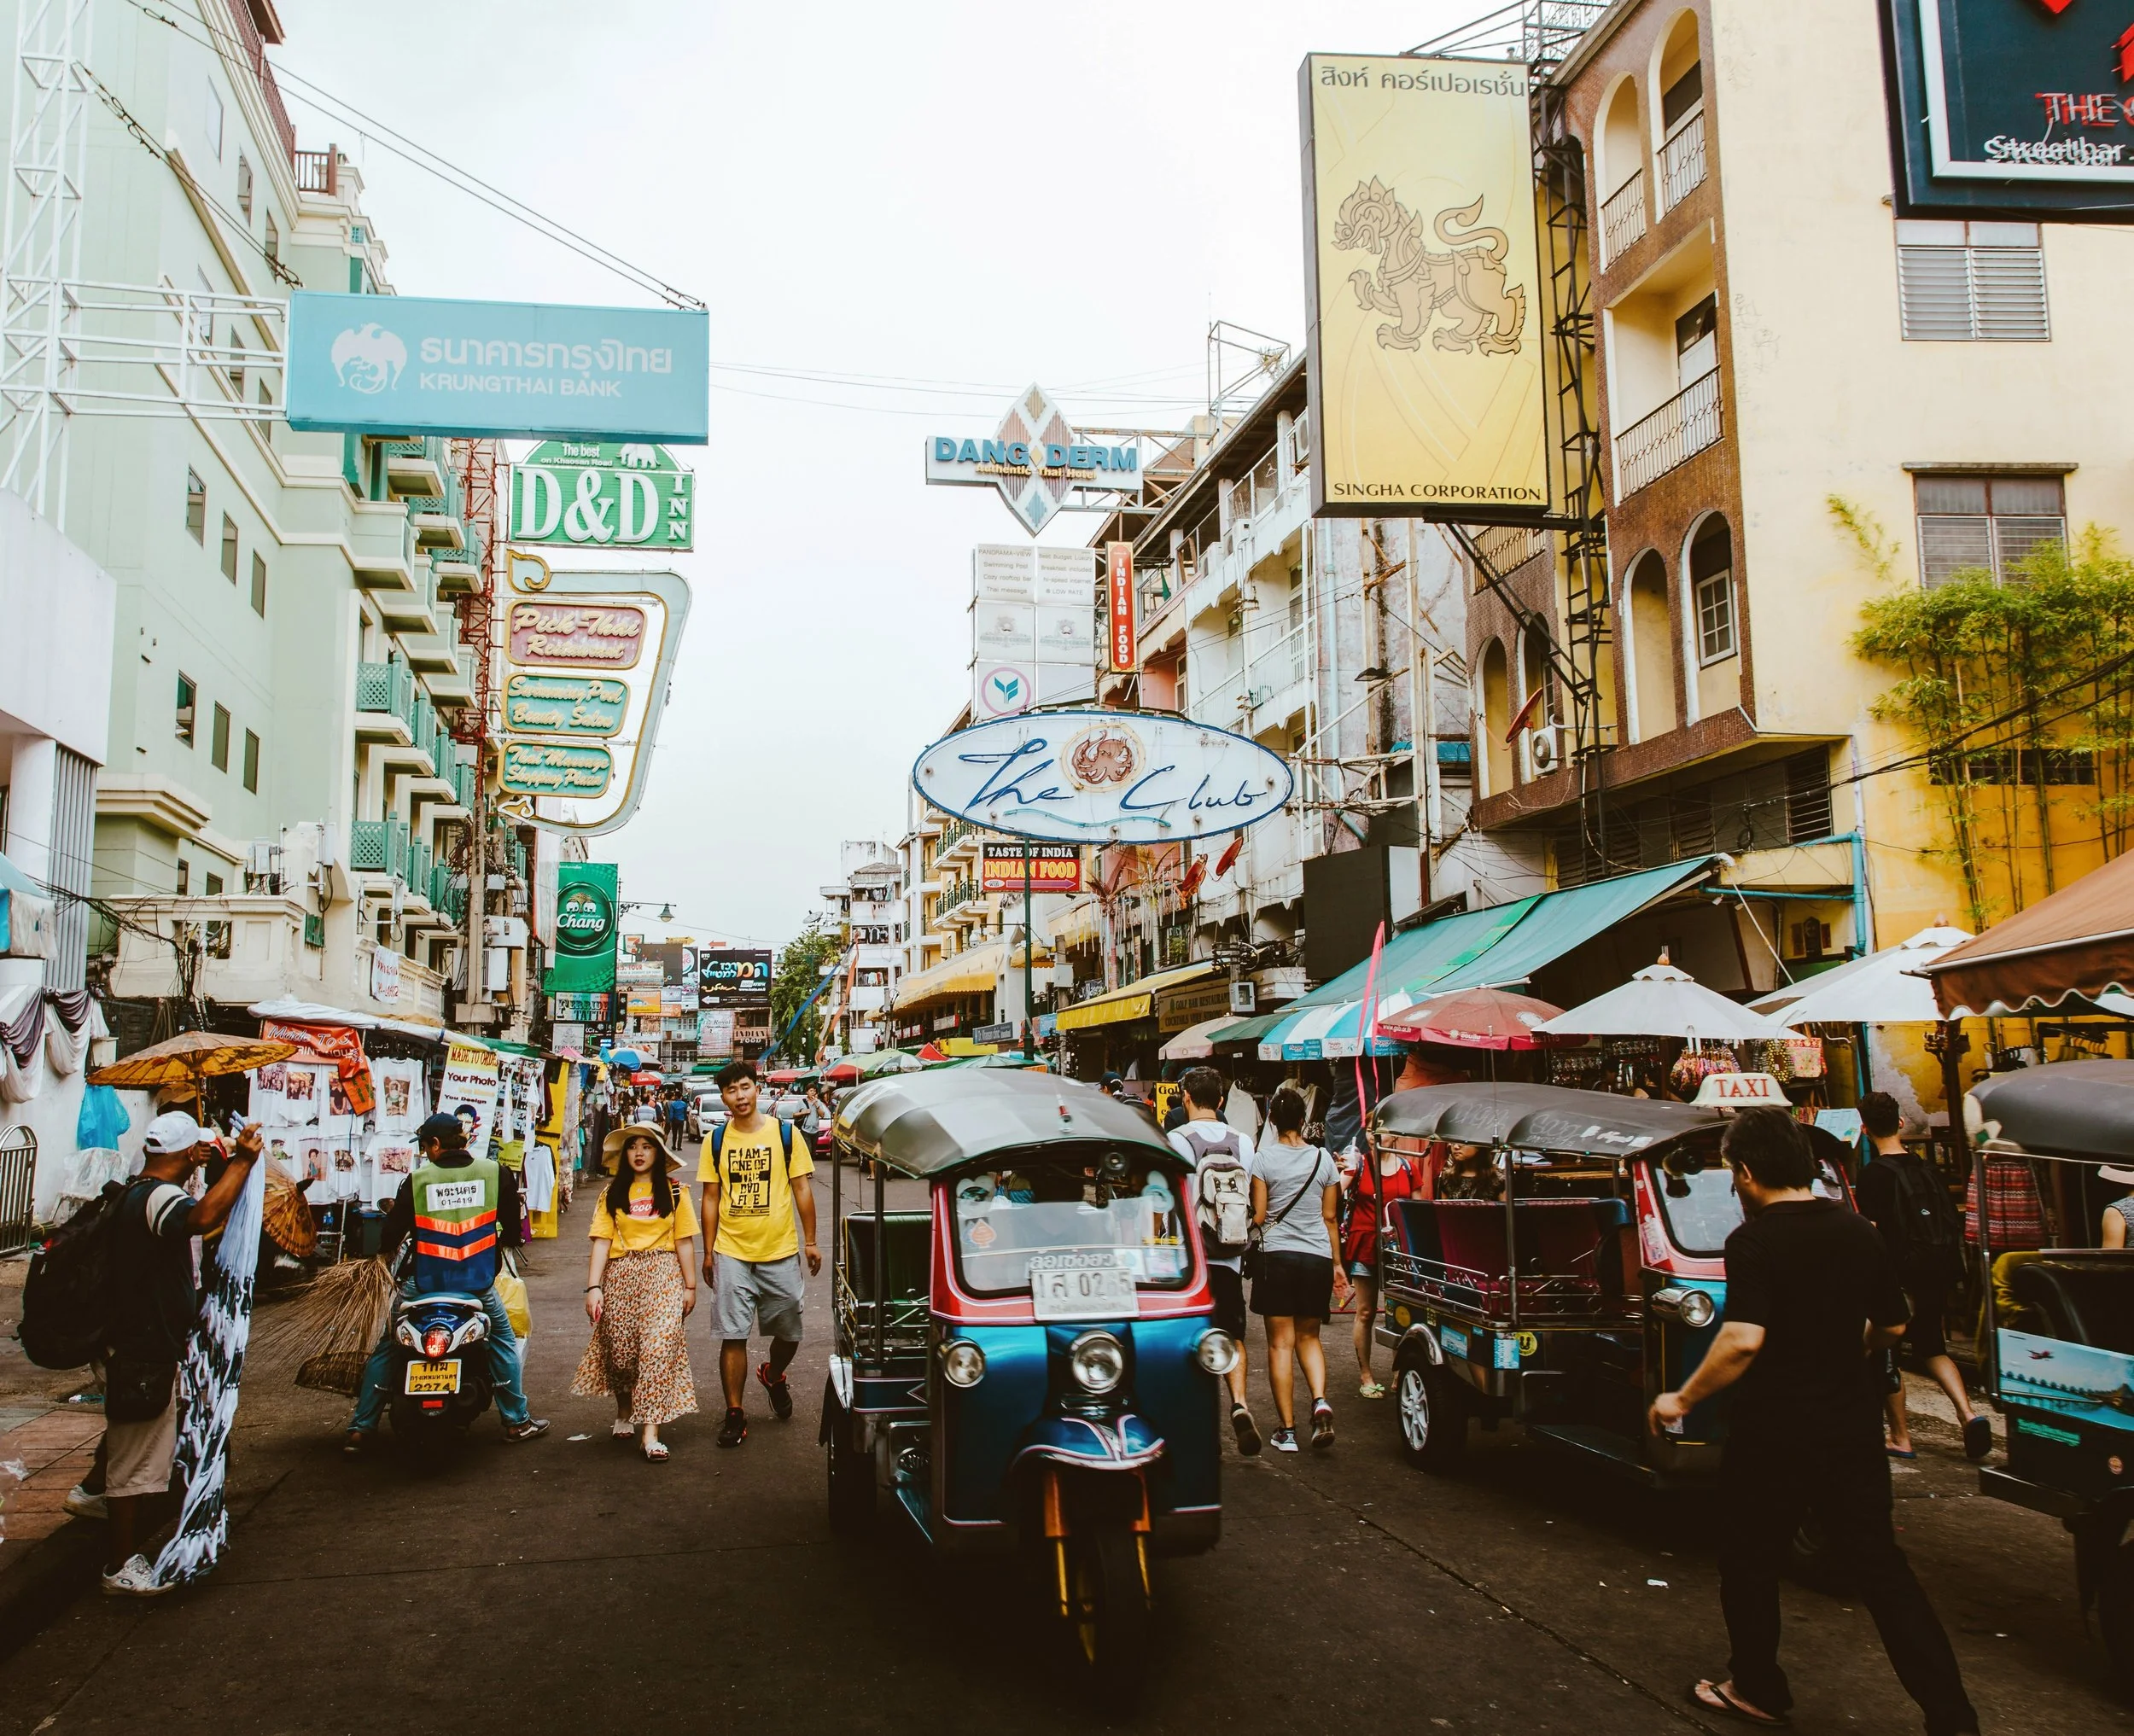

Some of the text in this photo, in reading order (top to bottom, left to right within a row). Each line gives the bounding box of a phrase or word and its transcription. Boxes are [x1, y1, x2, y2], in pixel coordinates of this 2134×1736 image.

[1321, 65, 1525, 97] สิงห์ คอร์เปอเรชั่น
[2035, 92, 2119, 126] THE
[420, 336, 672, 379] ธนาคารกรุงไทย
[420, 372, 621, 398] KRUNGTHAI BANK
[563, 443, 600, 458] The best
[935, 436, 1138, 472] DANG DERM
[554, 457, 590, 466] Khaosan
[592, 458, 613, 467] Road
[975, 463, 1098, 480] Authentic Thai Hotel
[1334, 482, 1541, 500] SINGHA CORPORATION
[515, 468, 689, 544] D&D INN
[1117, 559, 1128, 664] INDIAN FOOD
[526, 633, 624, 660] Restaurant
[587, 680, 624, 704] Pool
[508, 746, 544, 766] Thai
[959, 737, 1268, 813] The Club
[988, 847, 1023, 858] TASTE
[1041, 847, 1074, 857] INDIA
[1039, 861, 1076, 878] FOOD
[557, 913, 605, 932] Chang
[451, 1046, 469, 1063] MADE
[471, 1050, 480, 1064] TO
[447, 1072, 497, 1086] Your Photo
[1715, 1078, 1770, 1098] TAXI
[1158, 1086, 1178, 1095] Gol
[745, 1148, 761, 1159] AM
[755, 1159, 767, 1170] OF
[436, 1185, 477, 1197] พระนคร
[441, 1197, 472, 1206] 01-419
[411, 1373, 458, 1383] กรุงเทพมหานคร
